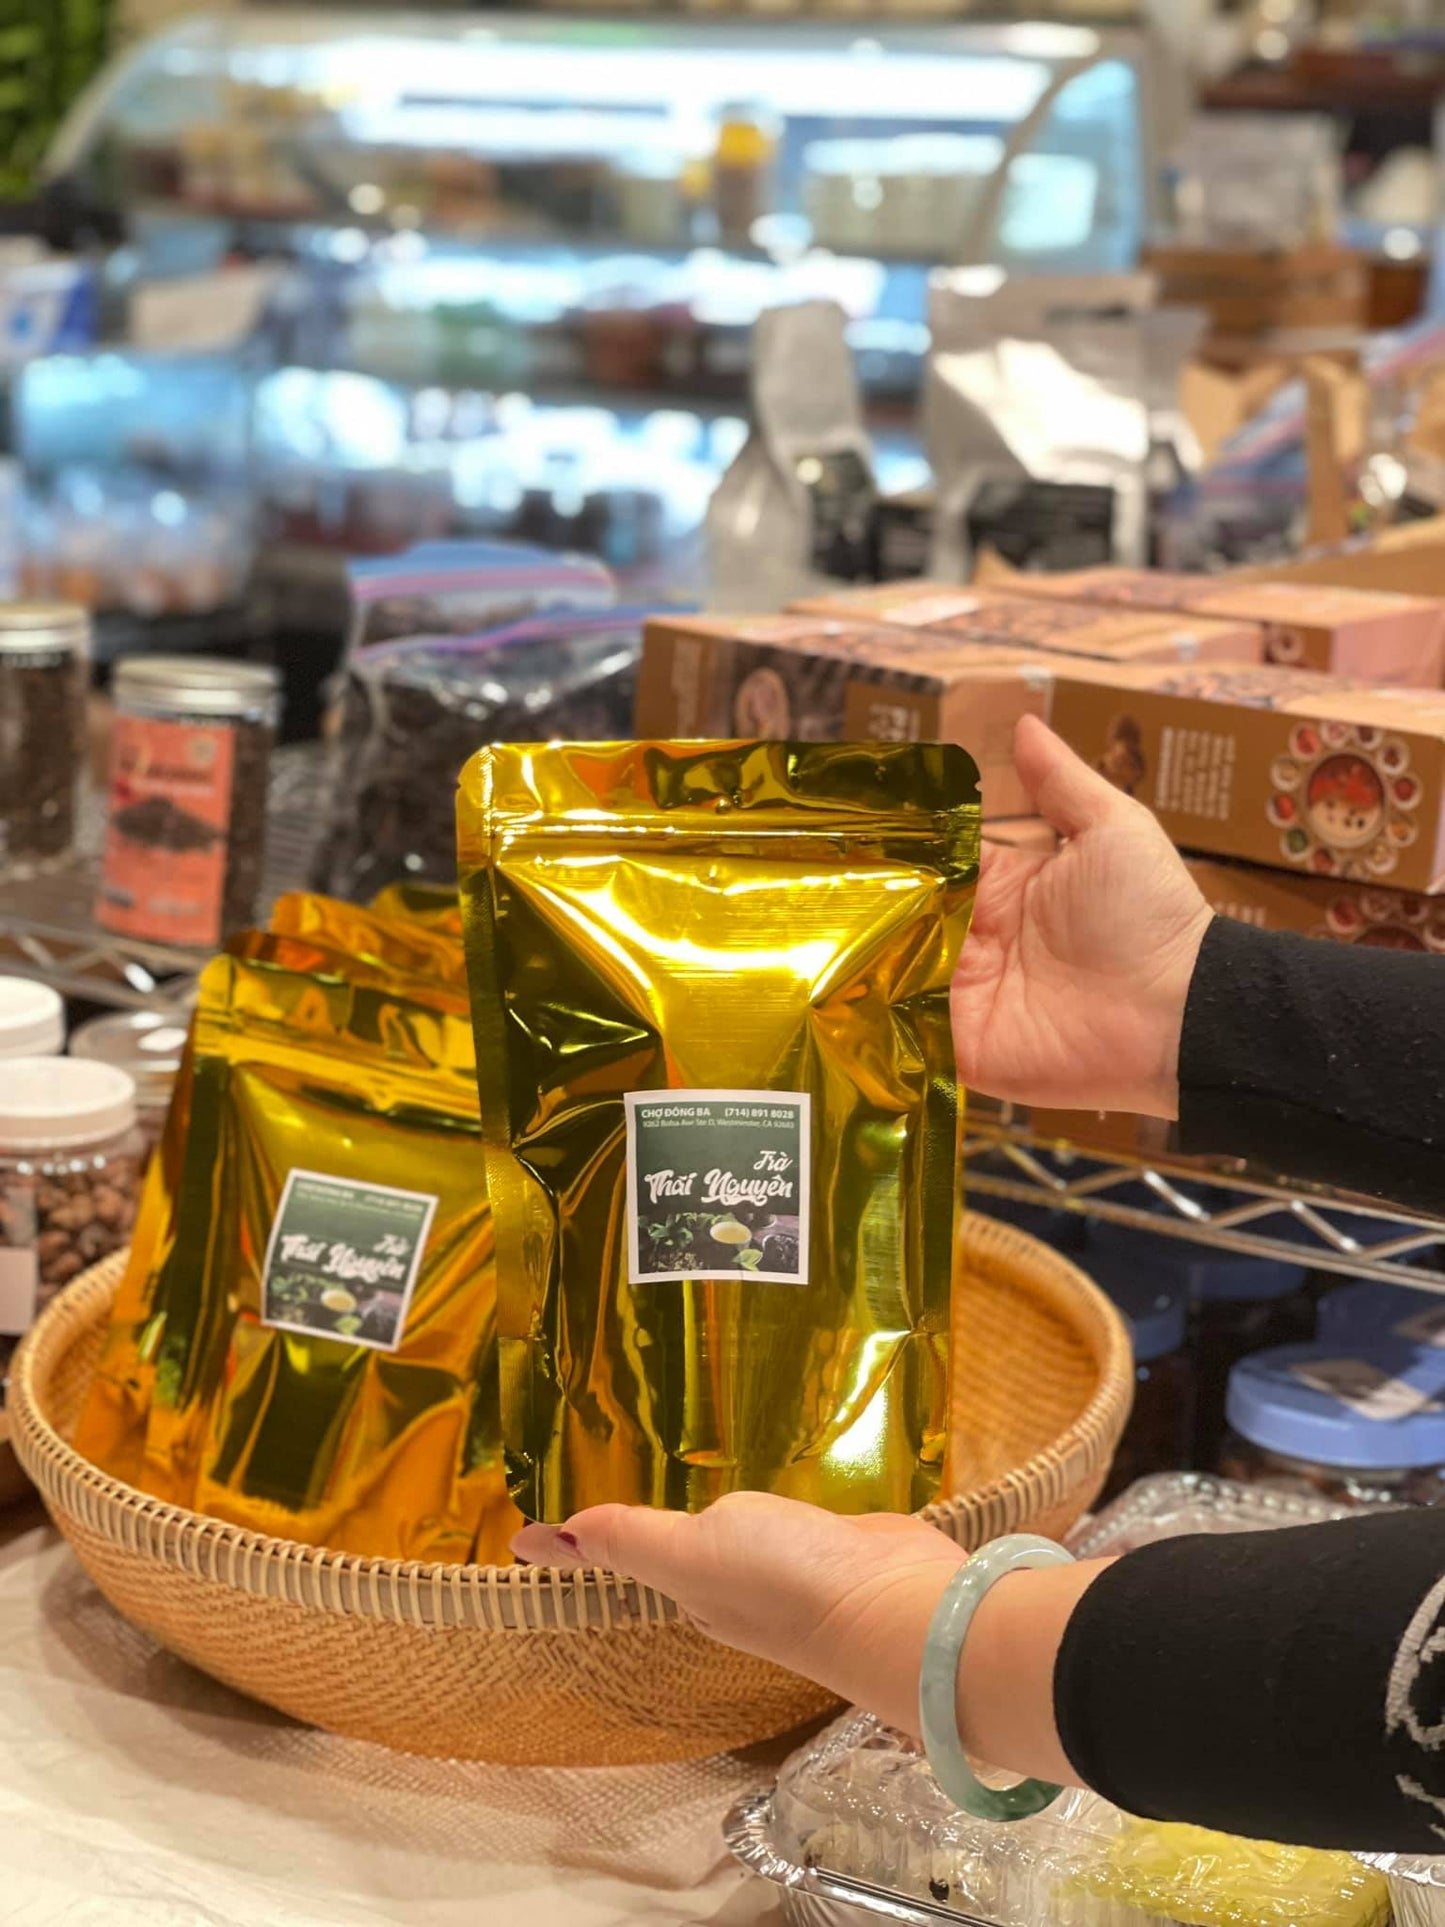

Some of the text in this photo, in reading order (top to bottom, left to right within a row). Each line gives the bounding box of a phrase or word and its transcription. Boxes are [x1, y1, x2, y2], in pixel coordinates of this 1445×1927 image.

[641, 1107, 663, 1119] CHỢ
[696, 1107, 711, 1117] BA
[725, 1107, 794, 1119] (714) 891 8028
[762, 1119, 773, 1128] CA
[753, 1150, 793, 1171] Trà
[701, 1168, 793, 1207] Nguyên
